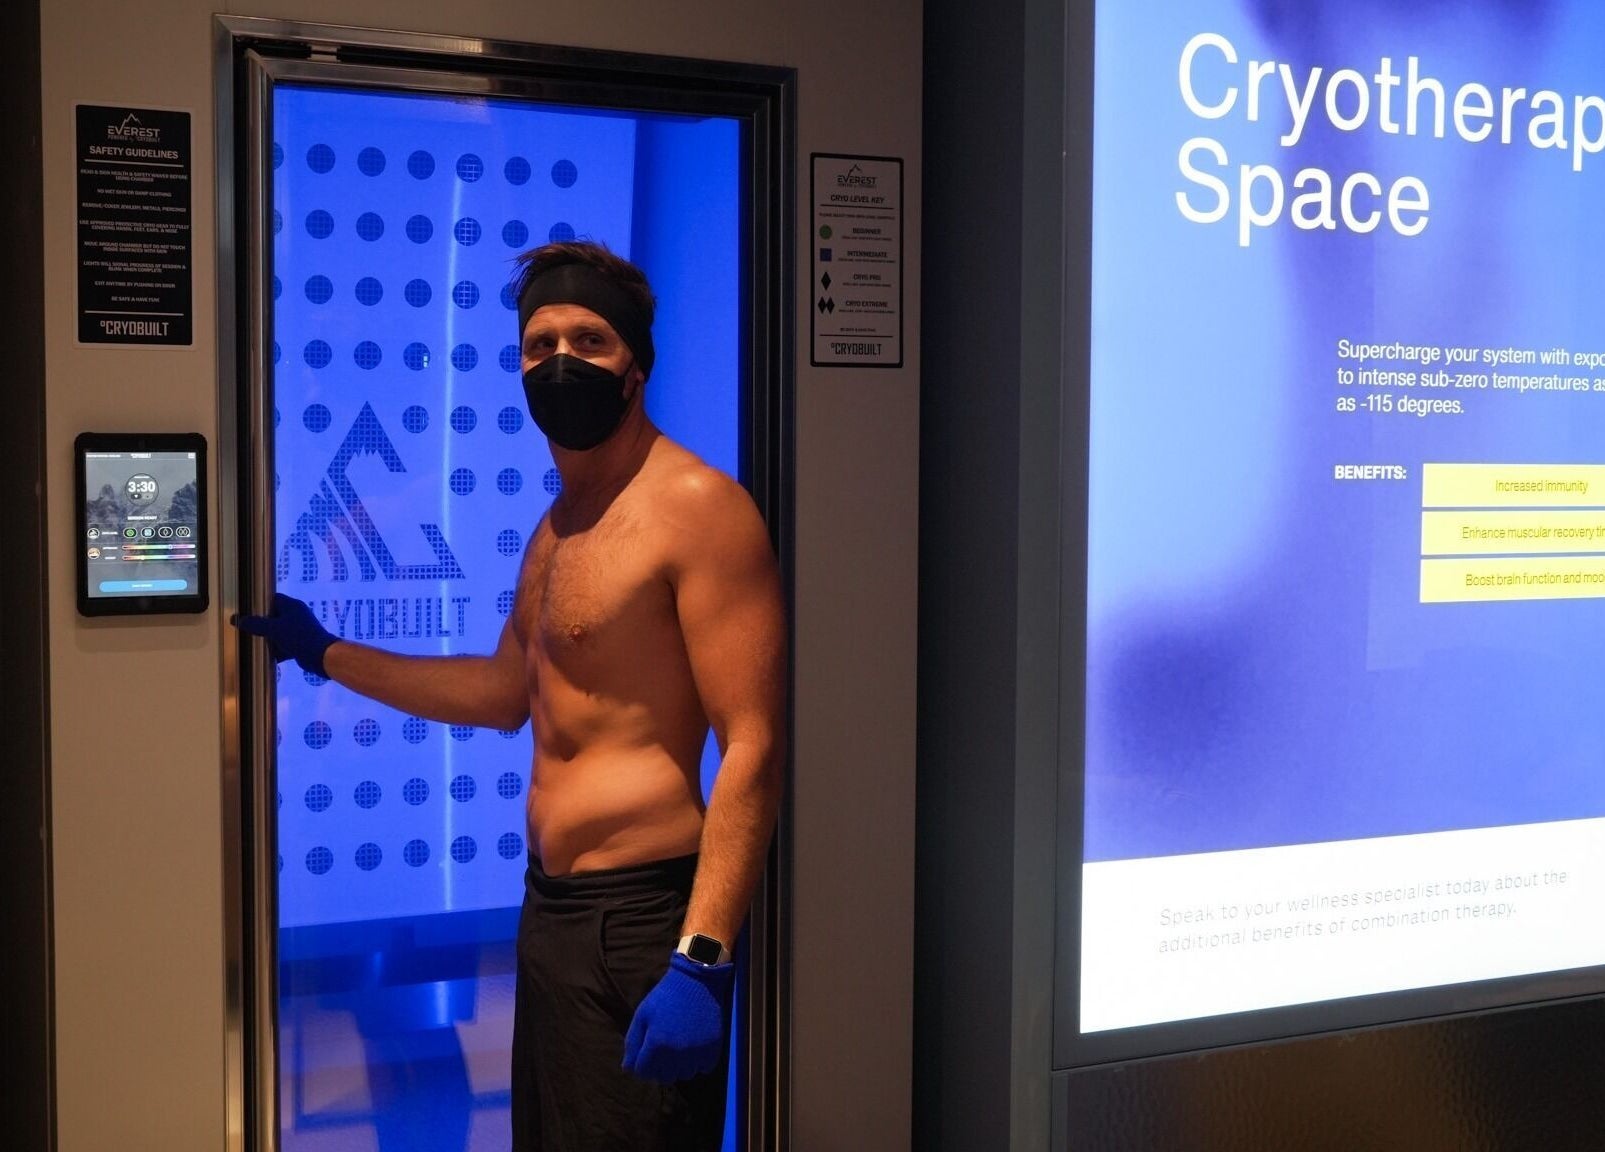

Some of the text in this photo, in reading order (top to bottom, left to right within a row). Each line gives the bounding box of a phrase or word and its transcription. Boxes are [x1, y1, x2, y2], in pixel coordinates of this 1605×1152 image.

[1179, 32, 1605, 171] Cryotherap
[107, 125, 160, 138] EVEREST
[89, 145, 179, 159] SAFETY GUIDELINES
[837, 174, 878, 185] EVEREST
[831, 194, 885, 204] CRYO LEVEL KEY
[1175, 137, 1430, 247] Space
[1338, 339, 1605, 371] Supercharge your system with expo
[1337, 367, 1354, 385] to
[1358, 368, 1416, 387] intense
[1420, 370, 1488, 389] sub-zero
[1493, 373, 1589, 393] temperatures
[1336, 394, 1465, 417] as -115 degrees.
[1334, 465, 1407, 480] BENEFITS:
[128, 481, 156, 493] 3:30
[1495, 480, 1589, 495] Increased immunity
[1462, 526, 1506, 539] Enhance
[1507, 526, 1552, 539] muscular
[1553, 527, 1595, 541] recovery
[1465, 574, 1495, 586] Boost
[1496, 573, 1521, 586] brain
[1522, 572, 1562, 585] function
[1563, 572, 1582, 584] and
[1159, 869, 1568, 929] Speak to your wellness specialist today about the
[1158, 902, 1517, 954] additional benefits of combination therapy.
